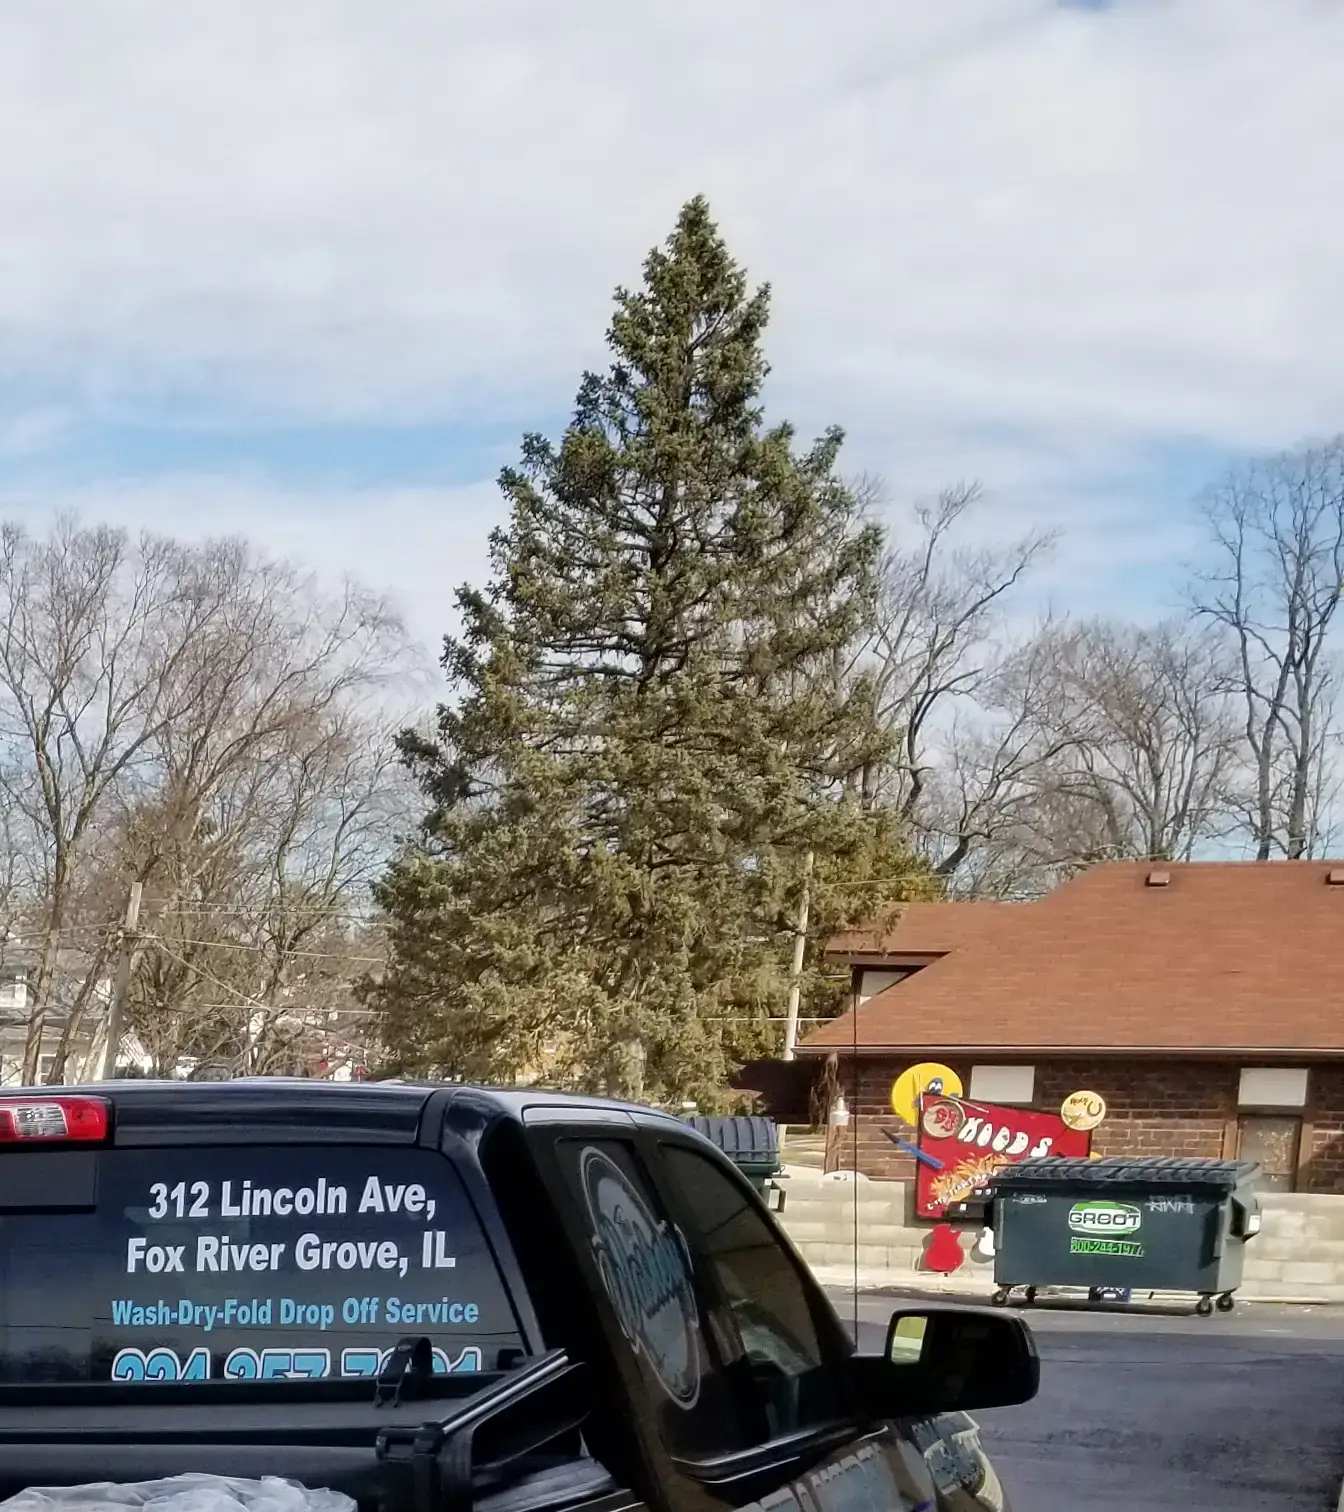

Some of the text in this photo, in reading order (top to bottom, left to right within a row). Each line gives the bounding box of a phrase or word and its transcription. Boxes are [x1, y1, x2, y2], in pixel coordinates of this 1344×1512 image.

[957, 1117, 1053, 1158] WOODS
[148, 1176, 436, 1221] 312 Lincoln Ave,
[1069, 1211, 1140, 1227] GROOT
[127, 1231, 456, 1278] Fox River Grove, IL
[112, 1297, 480, 1331] Wash-Dry-Fold Drop Off Service
